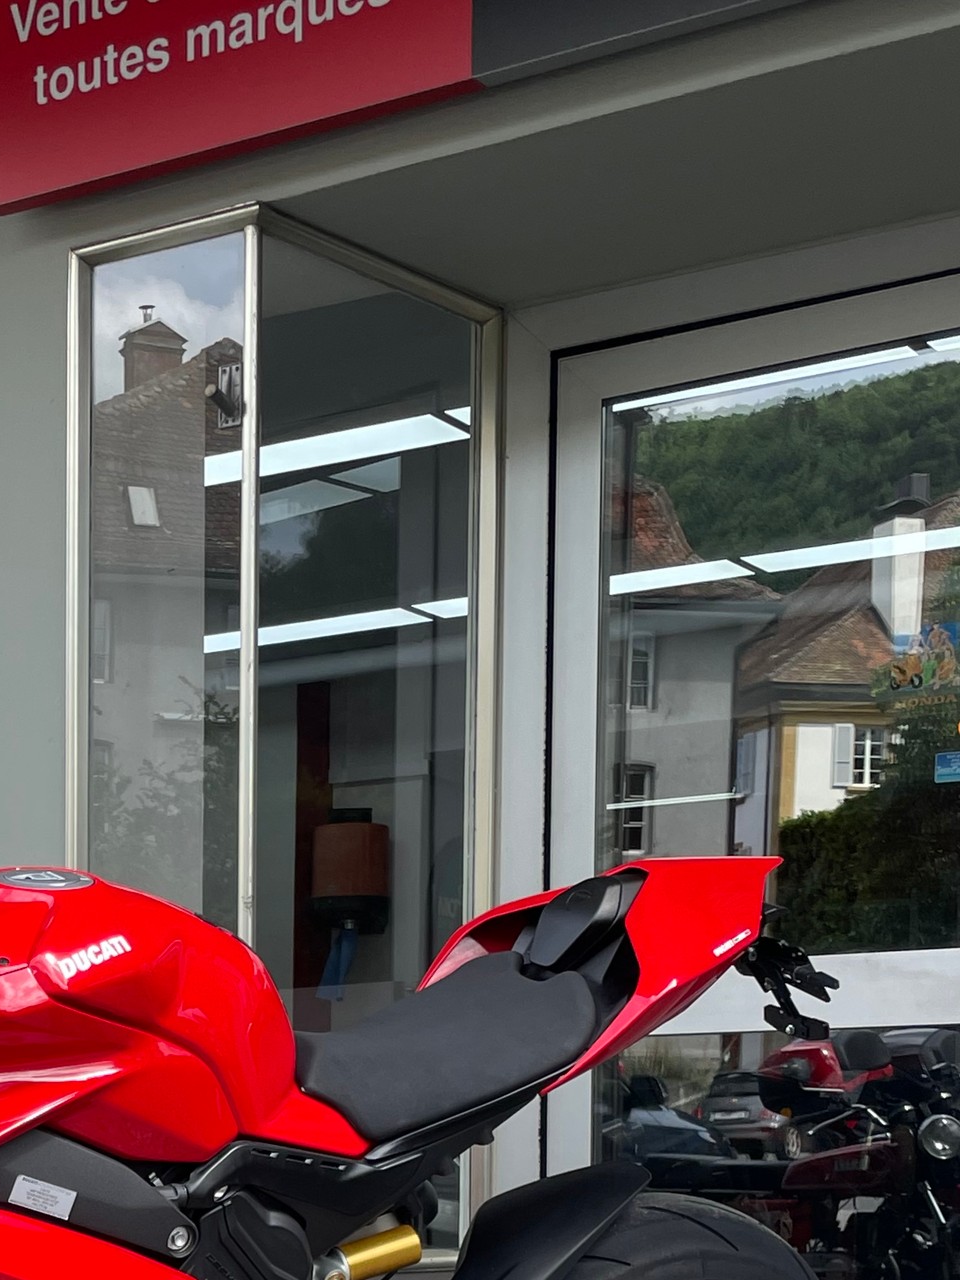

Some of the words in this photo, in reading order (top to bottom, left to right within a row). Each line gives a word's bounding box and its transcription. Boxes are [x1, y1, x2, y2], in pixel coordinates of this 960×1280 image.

[33, 37, 170, 105] toutes
[186, 0, 390, 62] marque
[58, 934, 132, 980] DUCATI
